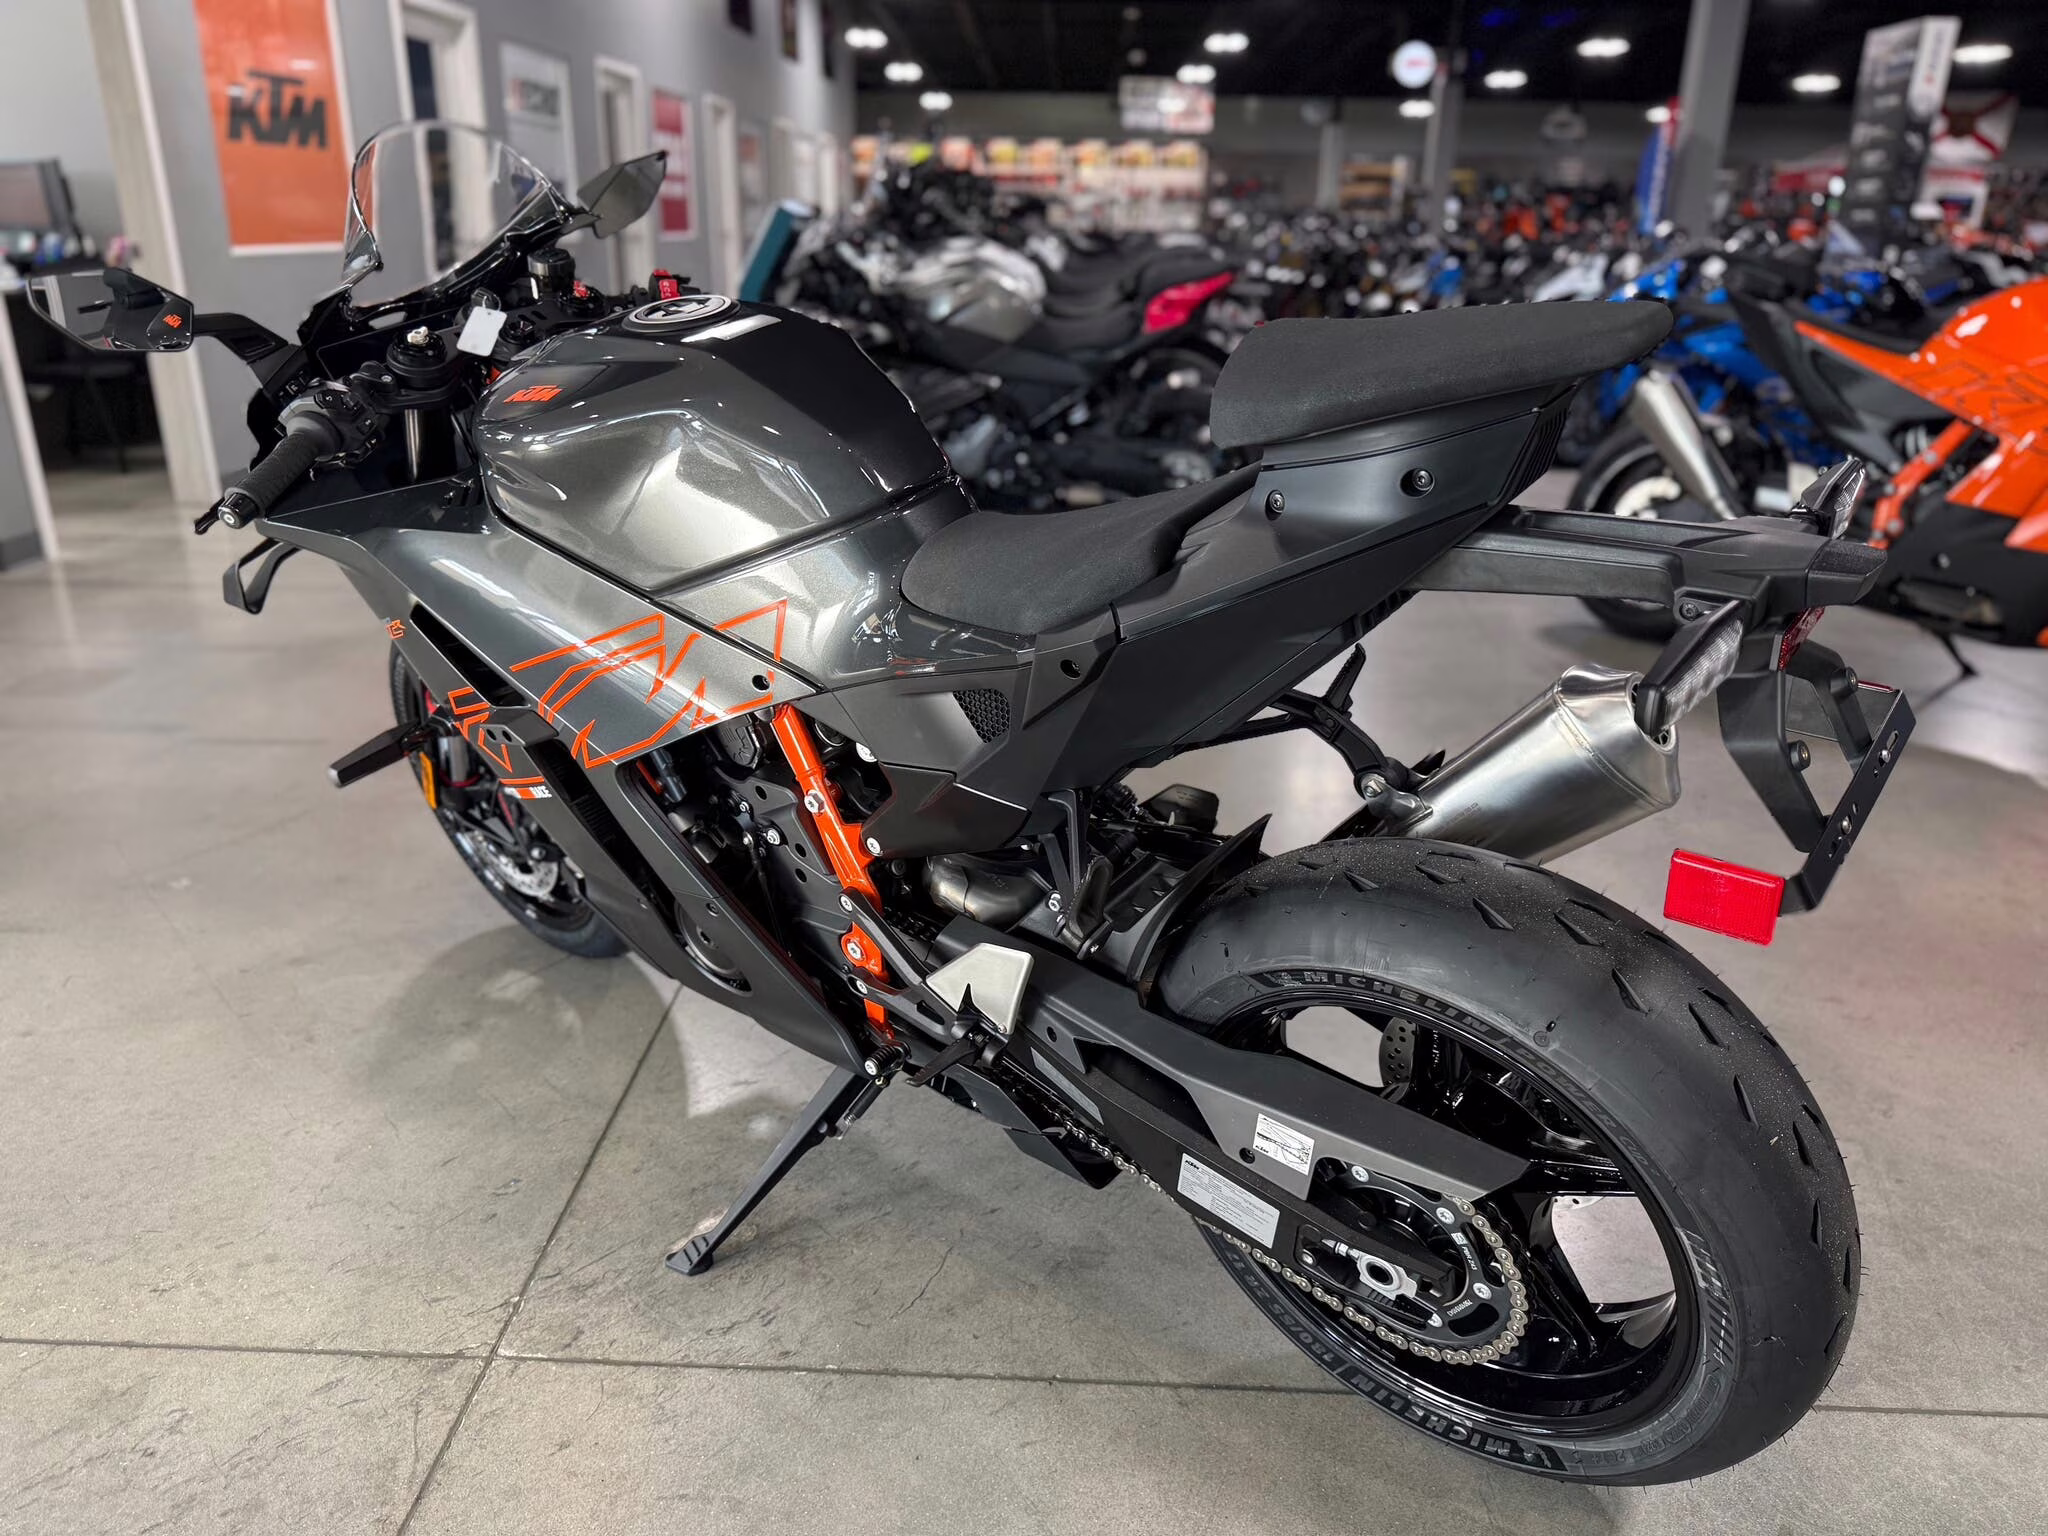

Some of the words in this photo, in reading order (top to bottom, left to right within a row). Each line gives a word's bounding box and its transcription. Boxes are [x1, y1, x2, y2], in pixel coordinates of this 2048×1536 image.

[228, 70, 326, 149] KTM
[503, 385, 563, 403] KTM
[1303, 971, 1491, 1033] MICHELIN
[1518, 1050, 1618, 1129] POWER
[1350, 1374, 1512, 1457] MICHELIN
